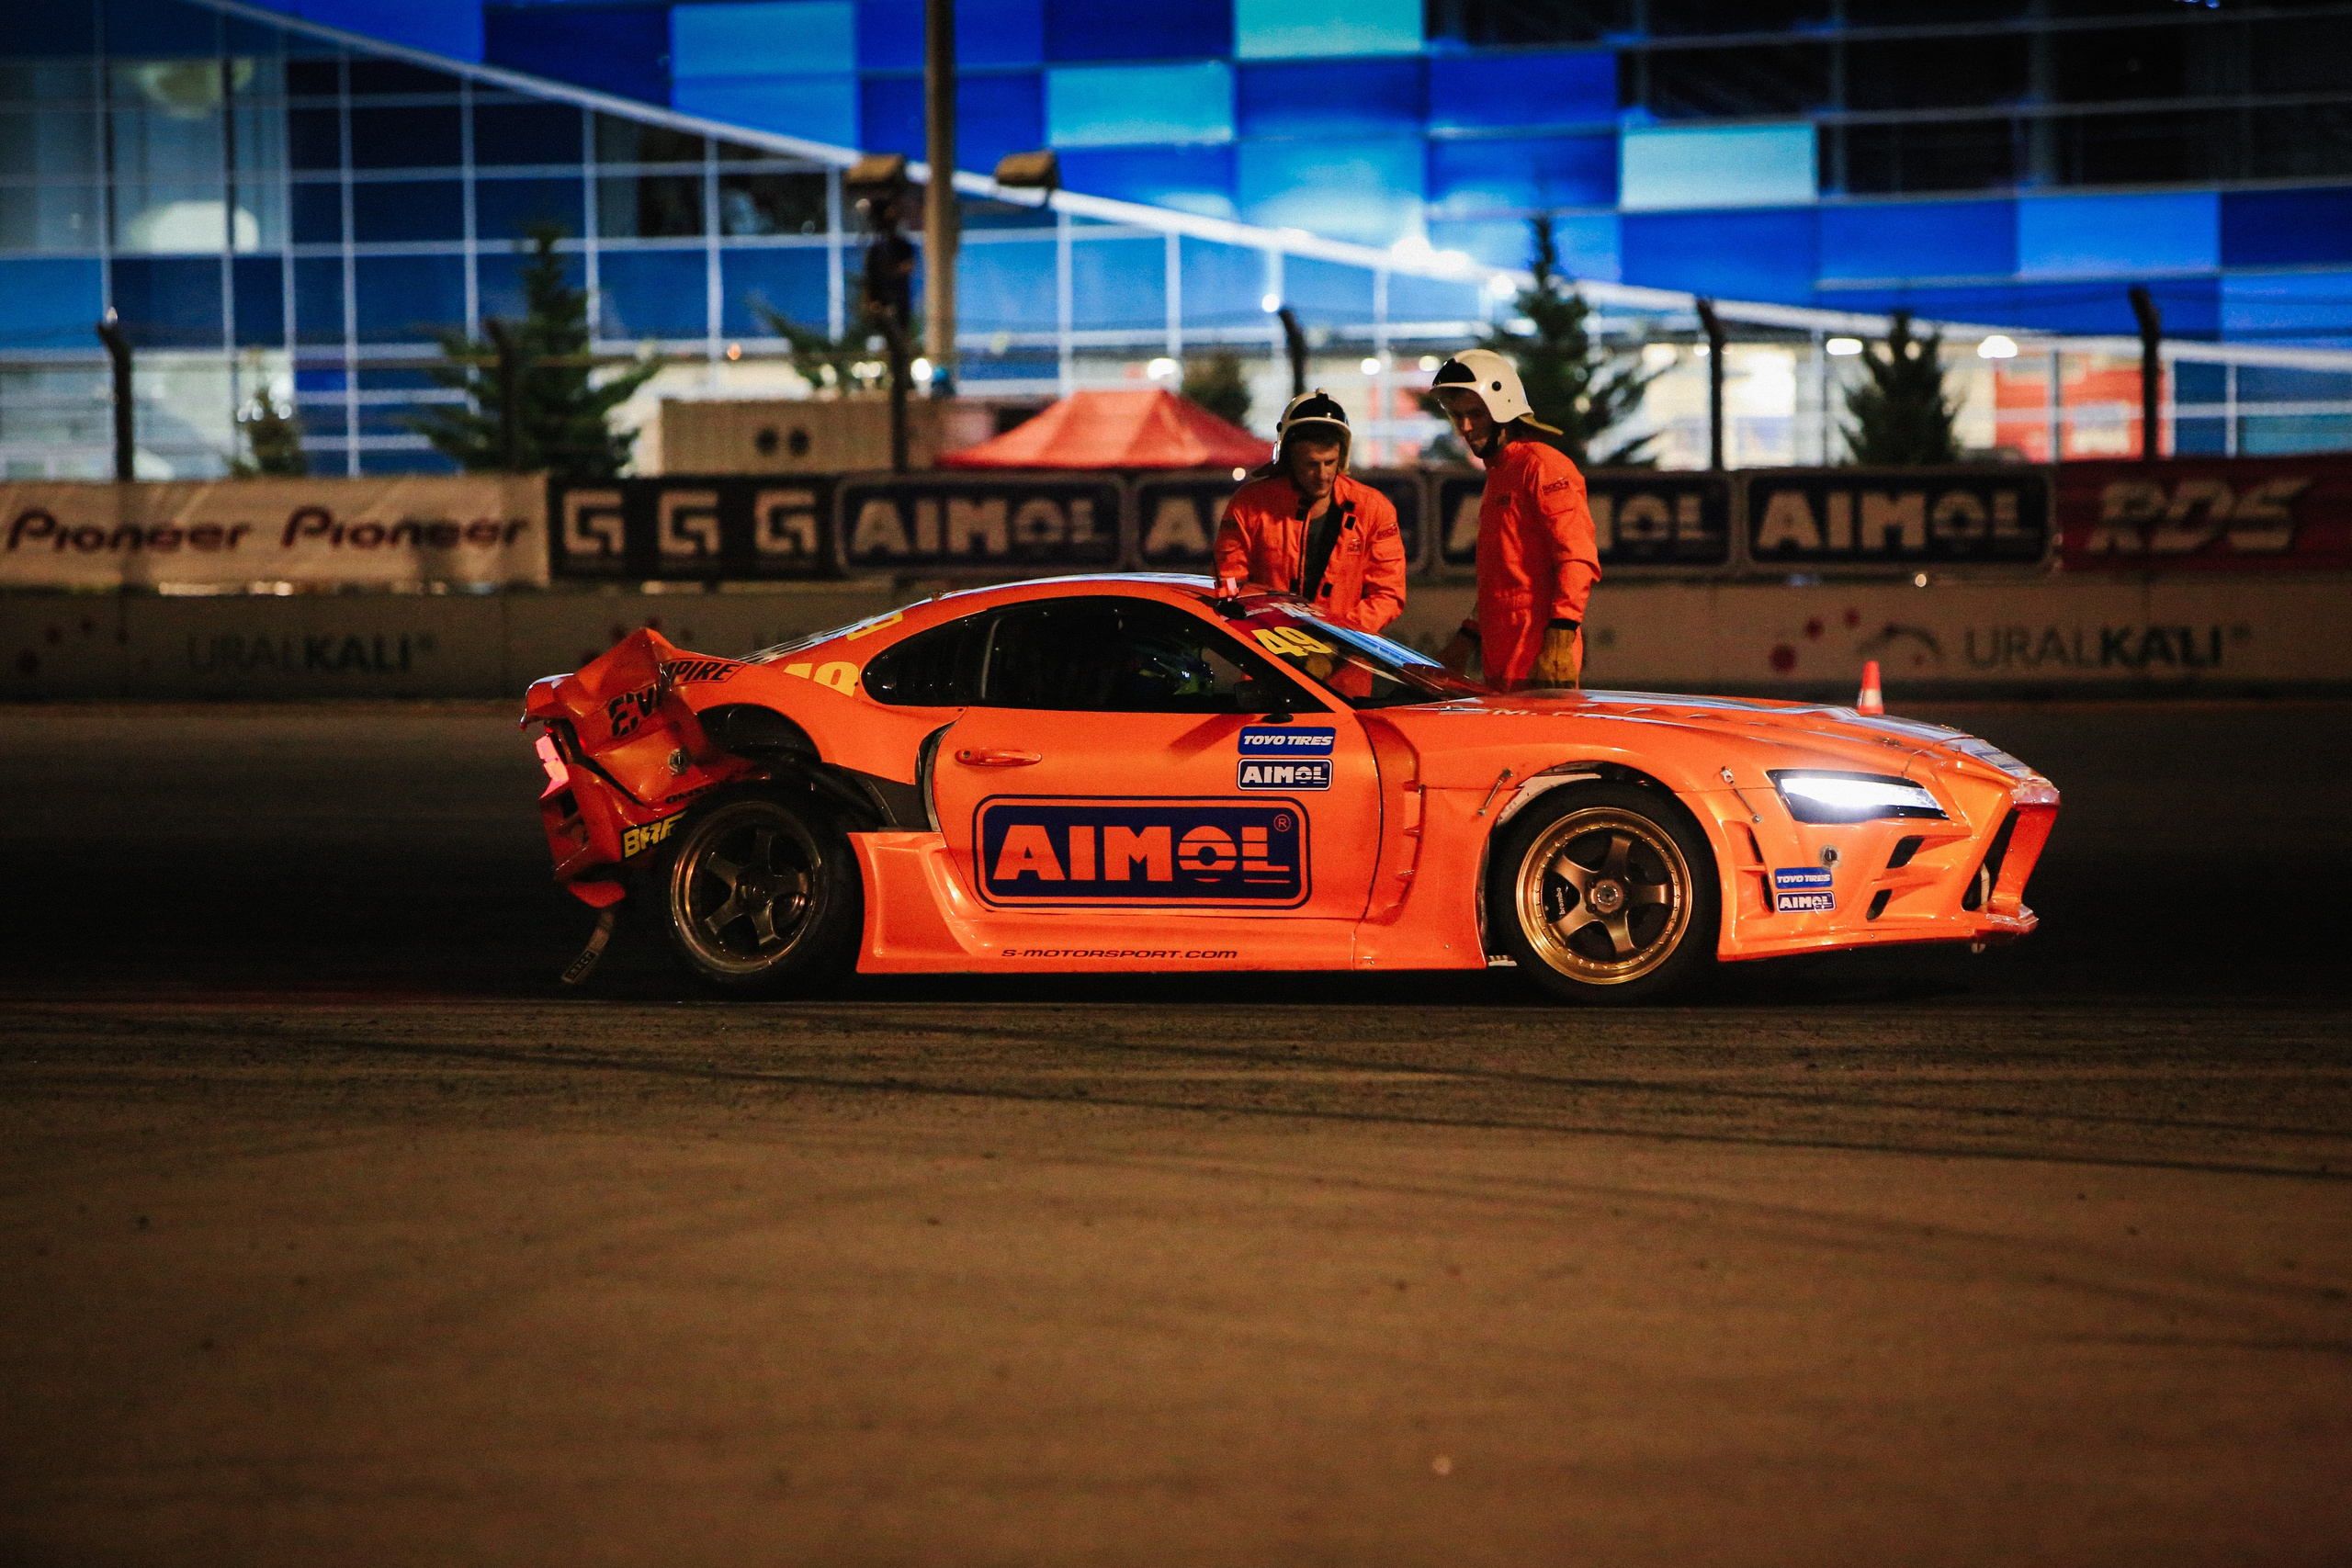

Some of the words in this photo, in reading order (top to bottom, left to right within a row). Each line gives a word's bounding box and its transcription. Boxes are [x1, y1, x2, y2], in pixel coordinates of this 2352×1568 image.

[6, 508, 252, 552] Pioneer
[280, 505, 530, 549] Pioneer
[851, 497, 1111, 555] AIMOL
[1757, 490, 2041, 549] AIMOL
[2086, 477, 2315, 551] RDS
[1250, 626, 1332, 657] 49
[1244, 736, 1285, 745] TOYO
[1287, 736, 1334, 746] TIRES
[1777, 874, 1804, 884] TOYO
[1804, 874, 1830, 883] TIRES
